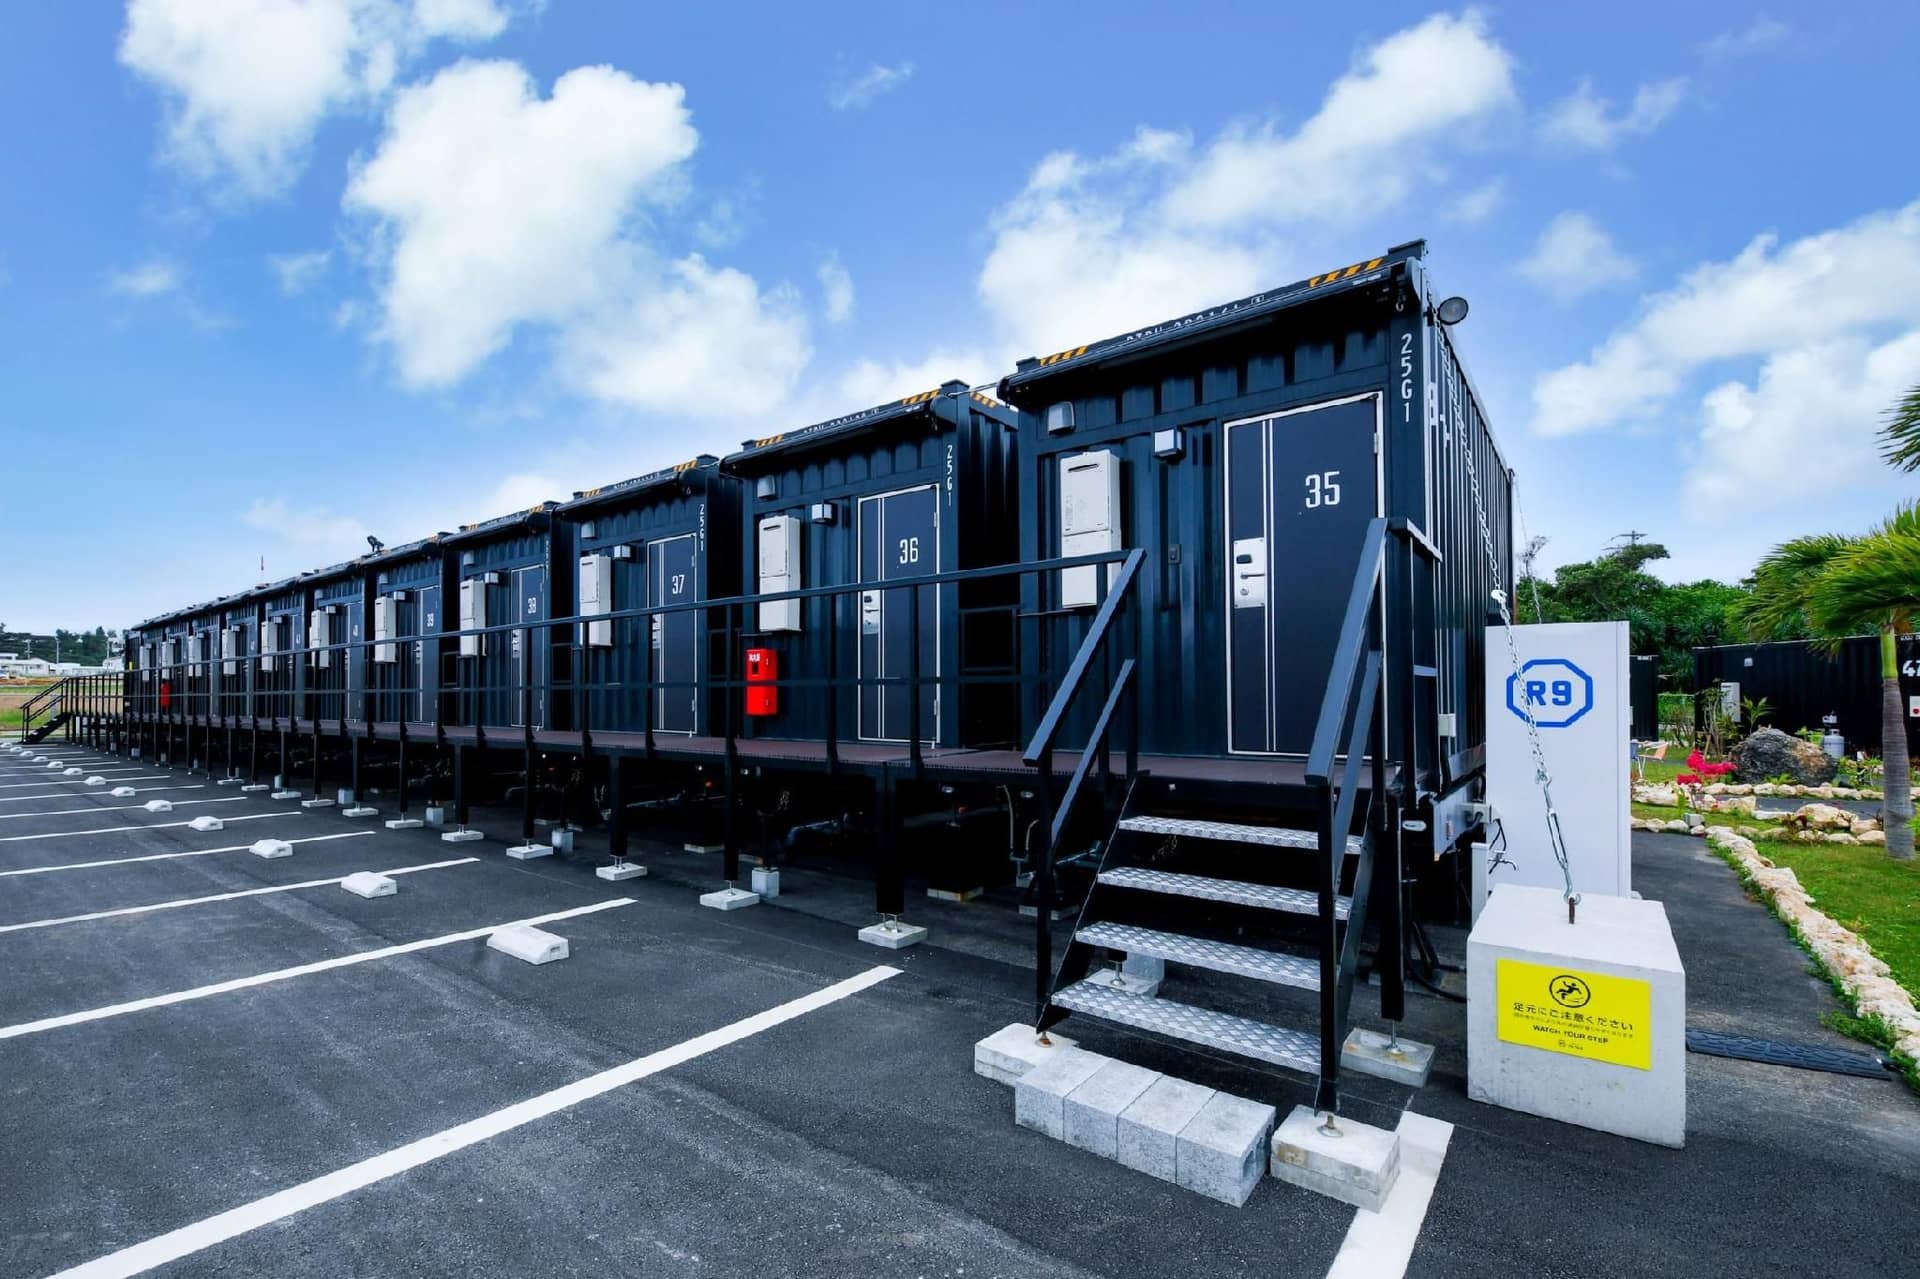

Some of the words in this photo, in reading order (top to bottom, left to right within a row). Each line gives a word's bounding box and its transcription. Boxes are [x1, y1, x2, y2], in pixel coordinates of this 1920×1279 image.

[1401, 332, 1413, 423] 25G1
[1305, 470, 1340, 508] 35
[899, 537, 919, 564] 36
[671, 574, 686, 594] 37
[1526, 680, 1572, 706] R9
[1513, 1002, 1633, 1031] 足元にご注意ください
[1532, 1024, 1561, 1034] WATCH
[1564, 1030, 1586, 1040] YOUR
[1587, 1034, 1609, 1044] STEP
